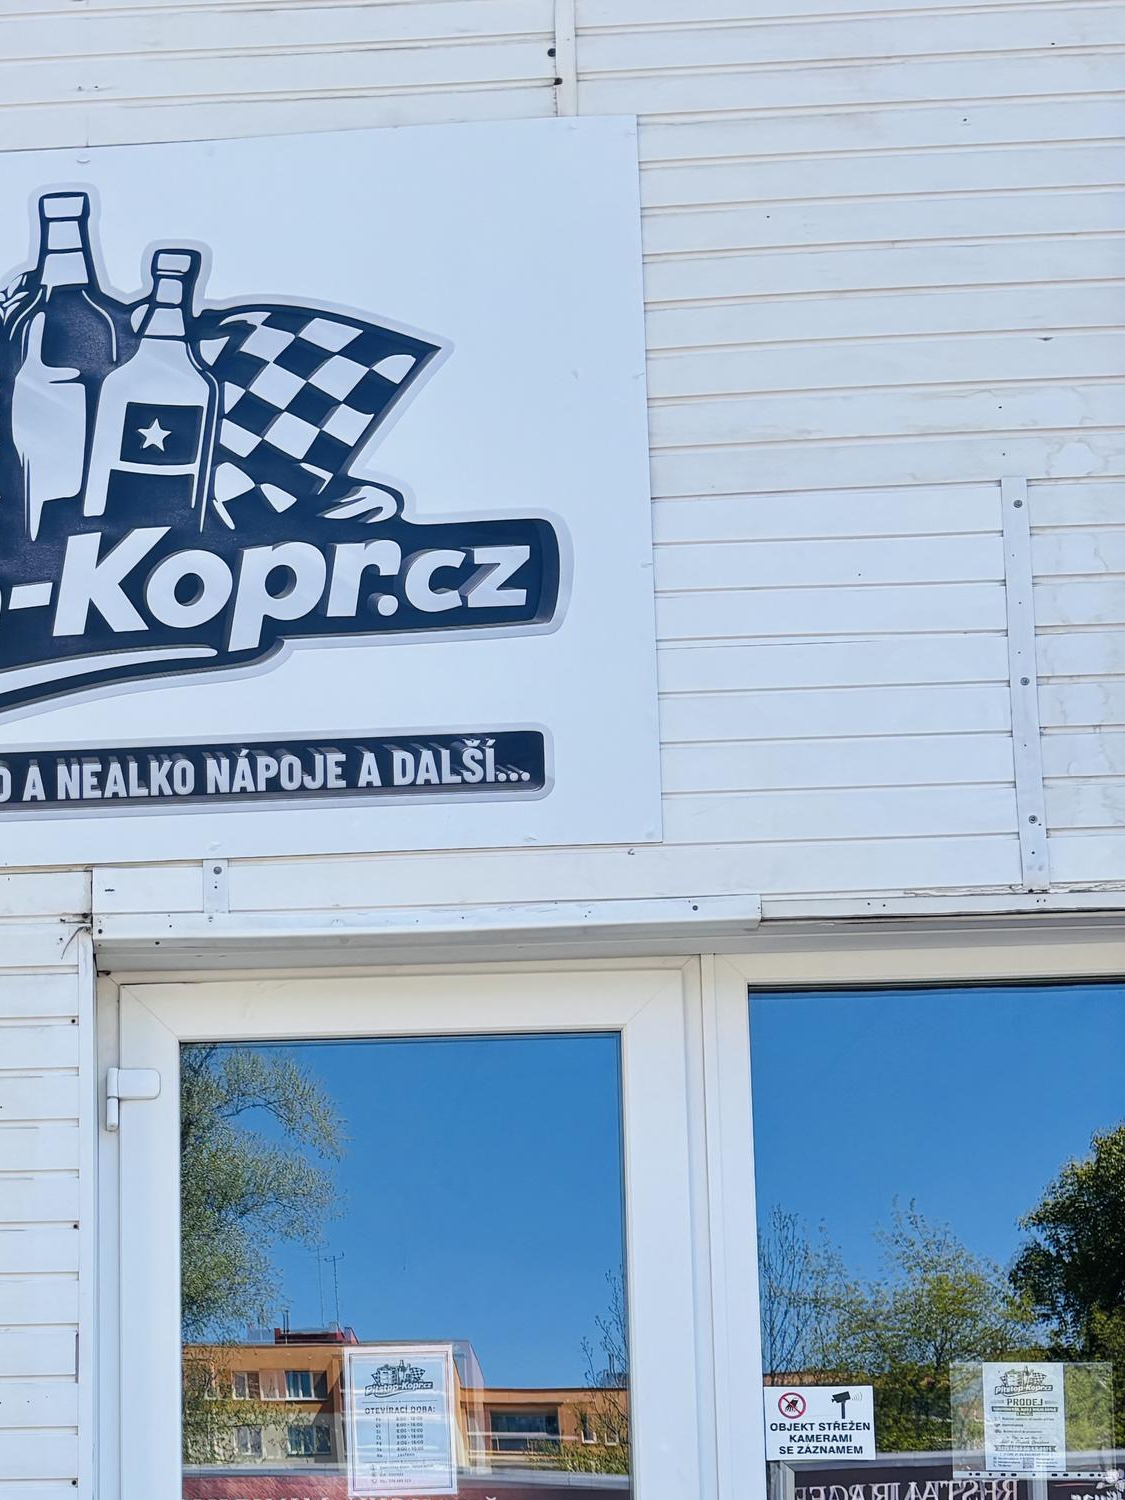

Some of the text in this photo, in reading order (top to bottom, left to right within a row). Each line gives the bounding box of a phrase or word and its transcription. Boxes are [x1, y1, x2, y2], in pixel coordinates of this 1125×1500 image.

[22, 763, 46, 801] A
[57, 760, 195, 801] NEALKO
[207, 750, 347, 794] NÁPOJE
[358, 752, 382, 788] A
[394, 738, 531, 786] DALŠÍ...
[770, 1420, 871, 1432] OBJEKT STŘEŽEN
[789, 1434, 852, 1443] KAMERAMI
[779, 1444, 863, 1454] SE ZÁZNAMEM
